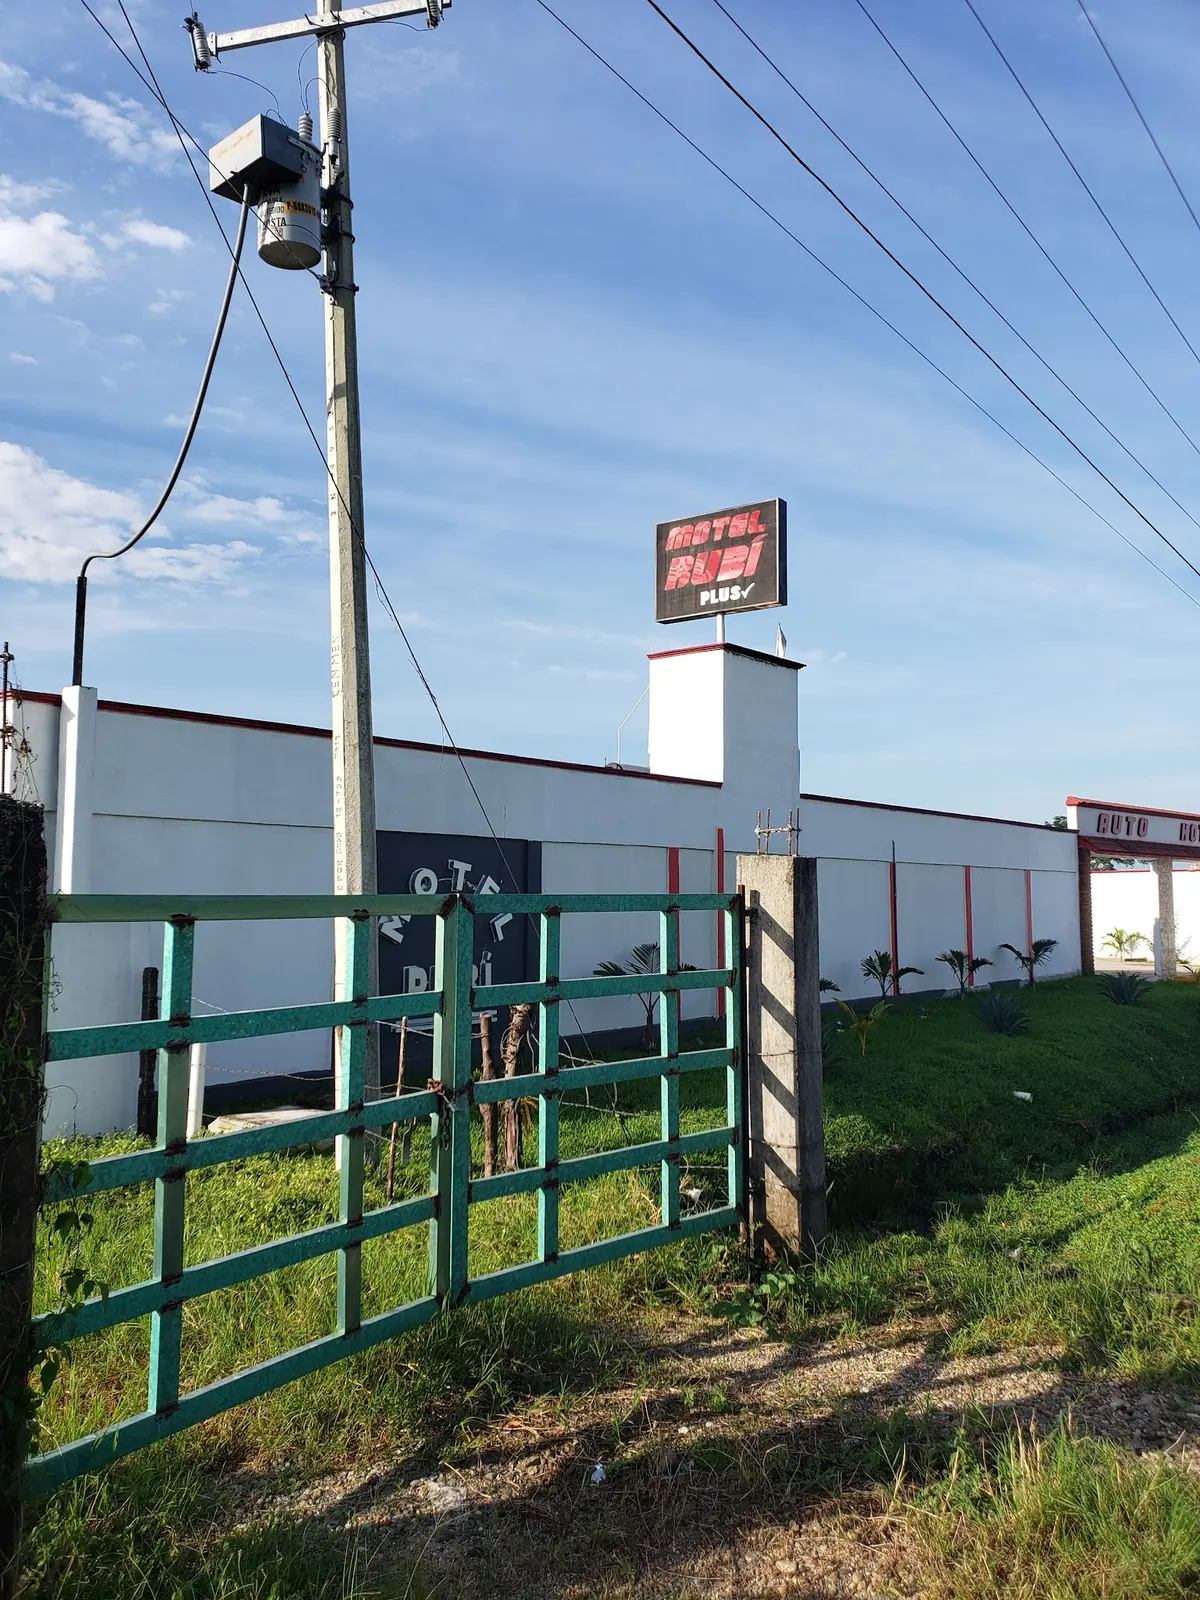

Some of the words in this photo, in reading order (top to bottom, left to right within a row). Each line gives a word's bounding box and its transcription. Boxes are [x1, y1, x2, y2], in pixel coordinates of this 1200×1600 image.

[665, 510, 766, 551] MOTEL
[700, 585, 741, 606] PLUS
[1096, 813, 1149, 838] AUTO
[1179, 822, 1200, 842] HO
